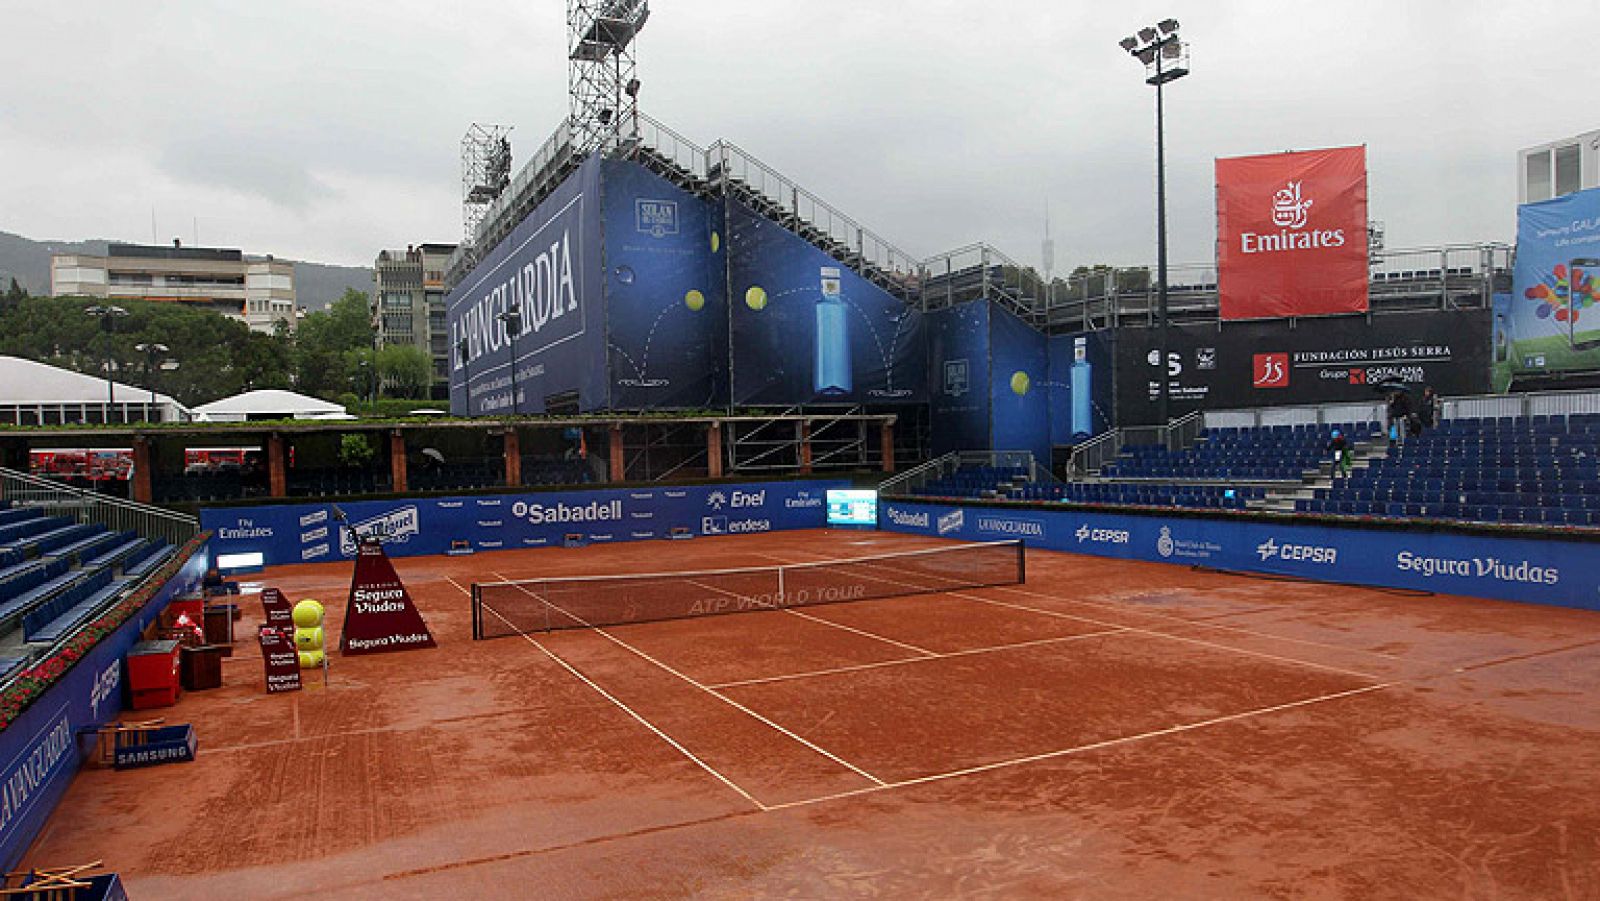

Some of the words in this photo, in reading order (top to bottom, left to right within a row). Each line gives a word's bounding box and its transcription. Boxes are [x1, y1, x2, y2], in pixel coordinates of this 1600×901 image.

[1241, 229, 1345, 253] Emirates
[1294, 349, 1367, 361] FUNDACIÓN
[1373, 346, 1407, 359] JESÚS
[1412, 345, 1450, 357] SERRA
[1320, 369, 1349, 380] Grupo
[731, 489, 766, 508] Enel
[529, 500, 622, 524] Sabadell
[219, 526, 273, 539] Emirates
[729, 518, 770, 533] endesa
[1091, 529, 1129, 543] CEPSA
[1280, 544, 1337, 564] CEPSA
[1397, 551, 1470, 576] Segura
[1473, 558, 1559, 584] Viudas
[354, 589, 403, 605] Segura
[688, 600, 728, 615] ATP
[818, 584, 866, 600] TOUR
[355, 602, 405, 614] Viudas
[349, 637, 388, 649] Segura
[389, 633, 428, 645] Viudas
[118, 746, 187, 764] SAMSUNG
